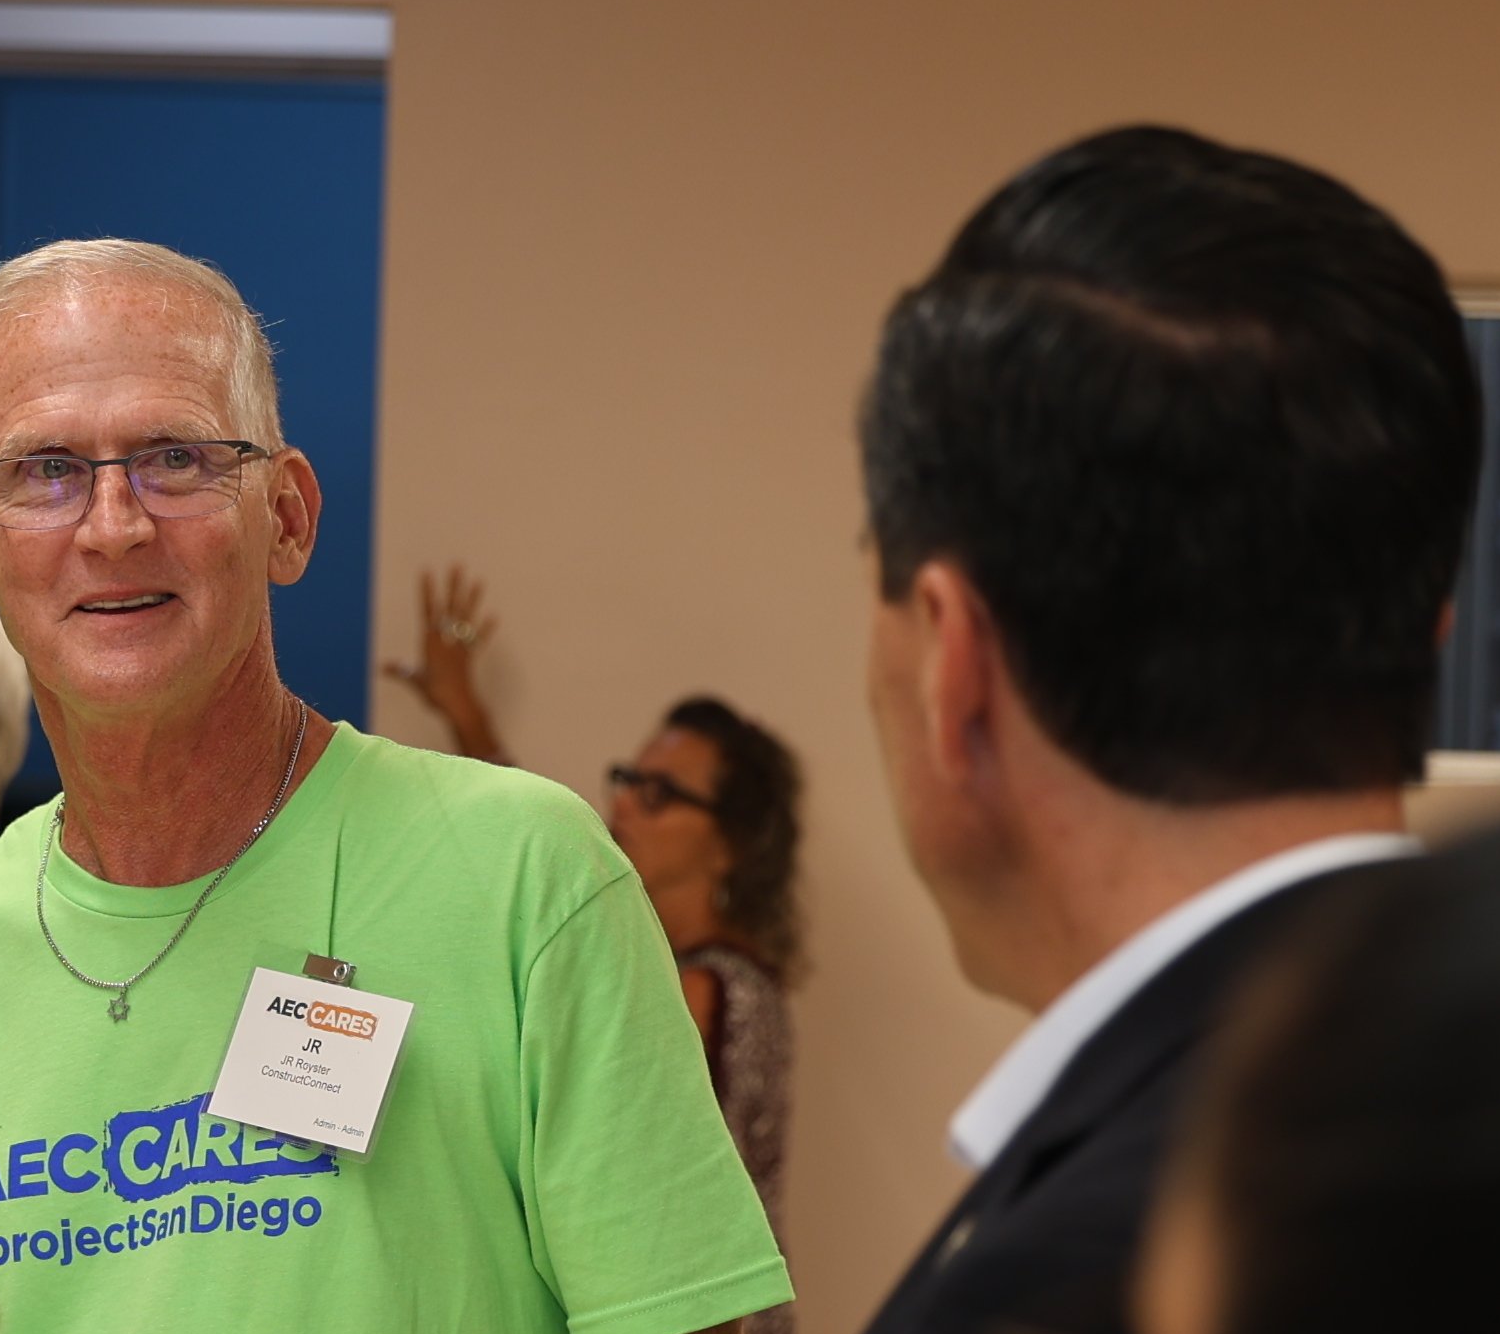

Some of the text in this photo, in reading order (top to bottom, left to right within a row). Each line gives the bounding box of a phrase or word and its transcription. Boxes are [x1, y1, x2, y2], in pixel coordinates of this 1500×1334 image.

[267, 996, 374, 1037] AEC CARES
[302, 1038, 322, 1055] JR
[280, 1055, 331, 1076] JR Royster
[261, 1065, 341, 1094] ConstructConnect
[312, 1118, 336, 1131] Admin
[342, 1125, 365, 1138] Admin
